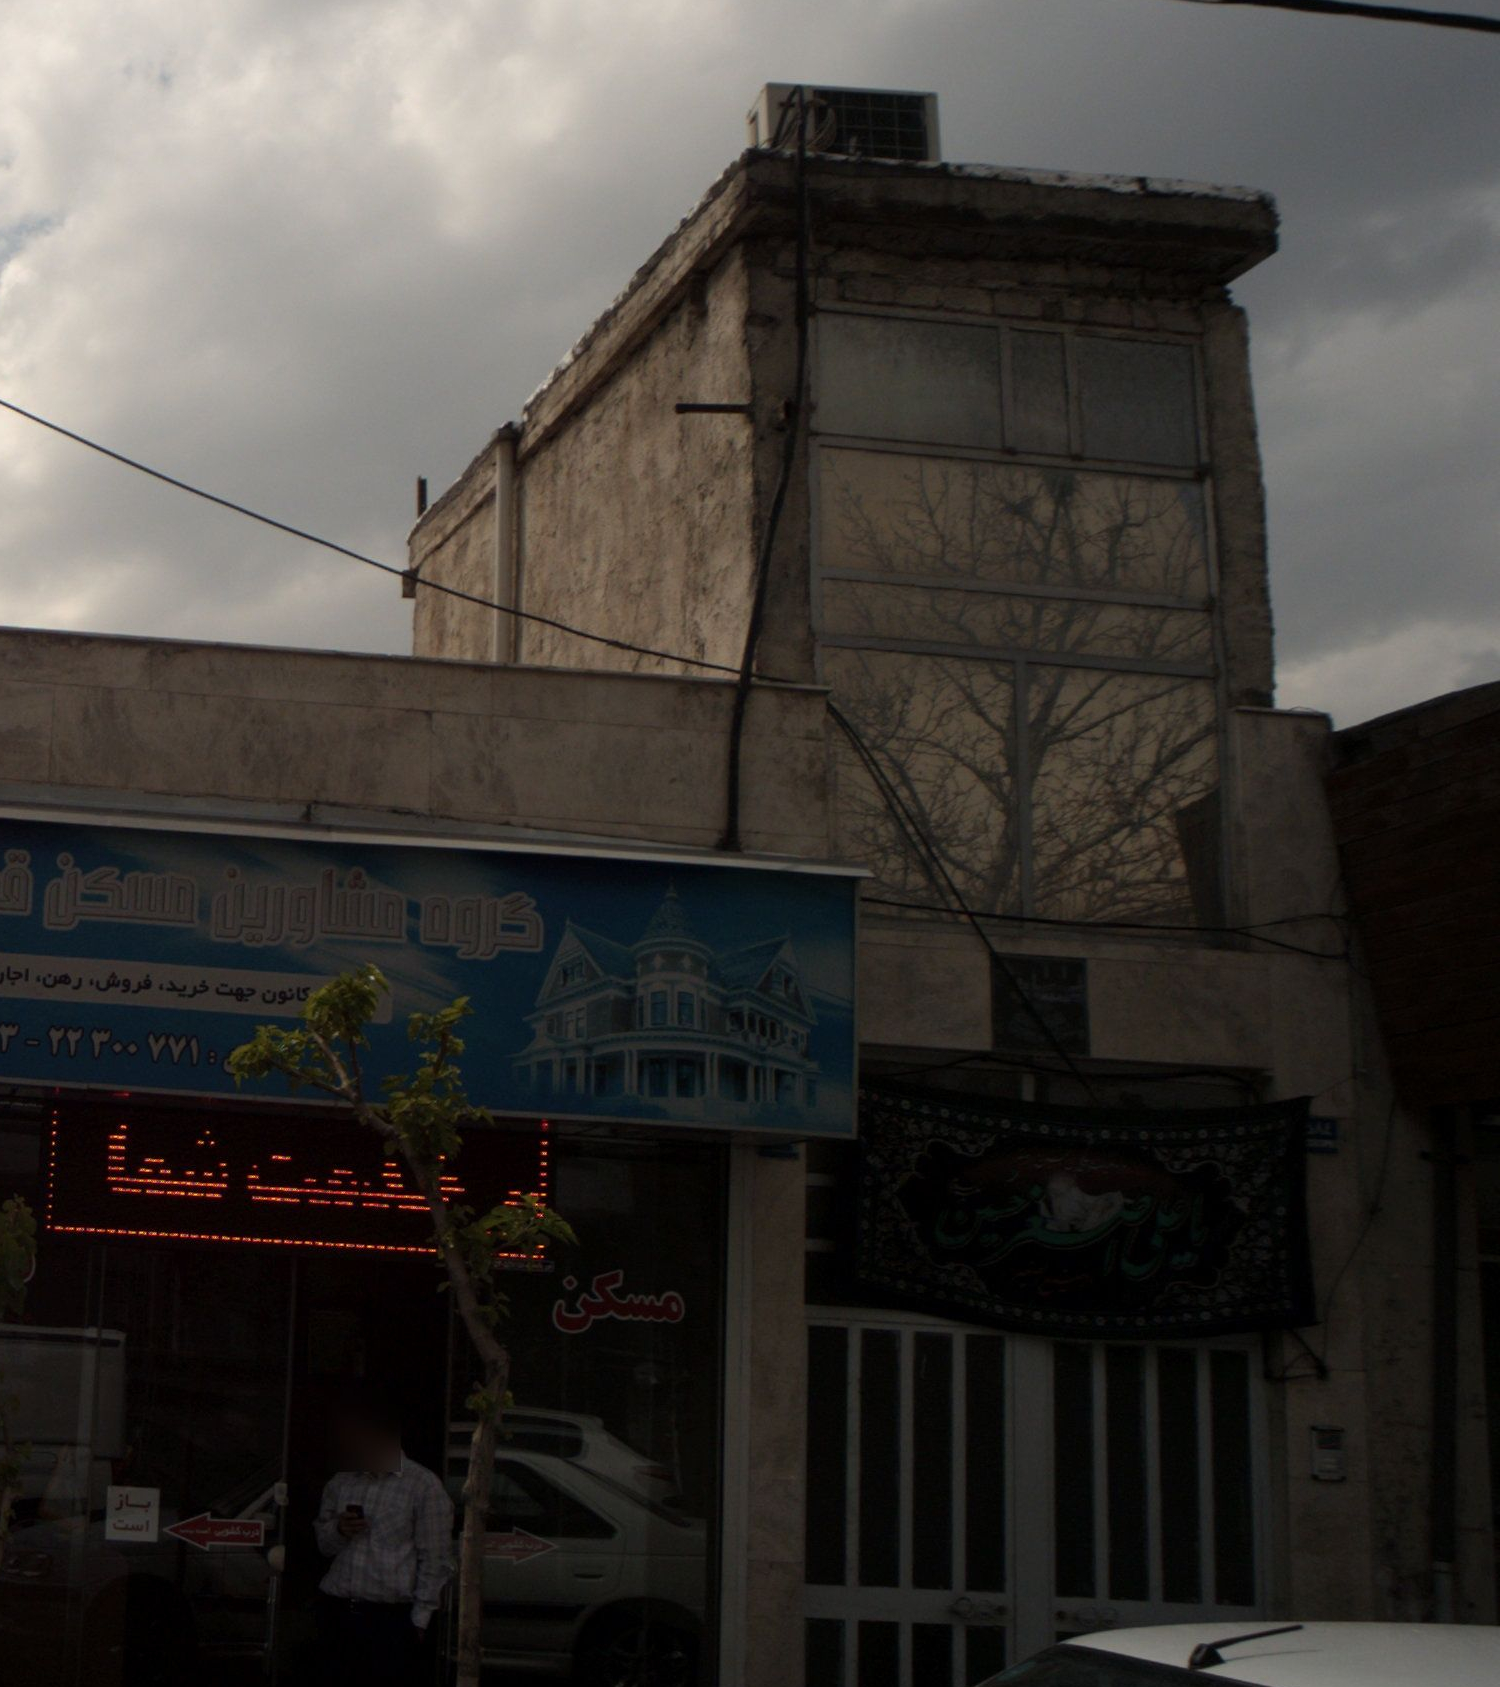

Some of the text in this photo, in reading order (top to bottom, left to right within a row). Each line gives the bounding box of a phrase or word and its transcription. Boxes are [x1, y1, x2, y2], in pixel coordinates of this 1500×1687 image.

[42, 851, 200, 932] مسکن
[210, 864, 407, 949] مشاورین
[419, 890, 545, 961] گروه
[36, 968, 83, 990] رهن،
[89, 970, 153, 994] فروش،
[158, 973, 210, 998] خرید،
[215, 983, 257, 1003] جهت
[47, 1024, 84, 1058] ۲۲
[147, 1031, 199, 1066] ۷۷۱
[552, 1269, 686, 1334] مسکن
[114, 1493, 152, 1513] باز
[111, 1518, 150, 1532] است
